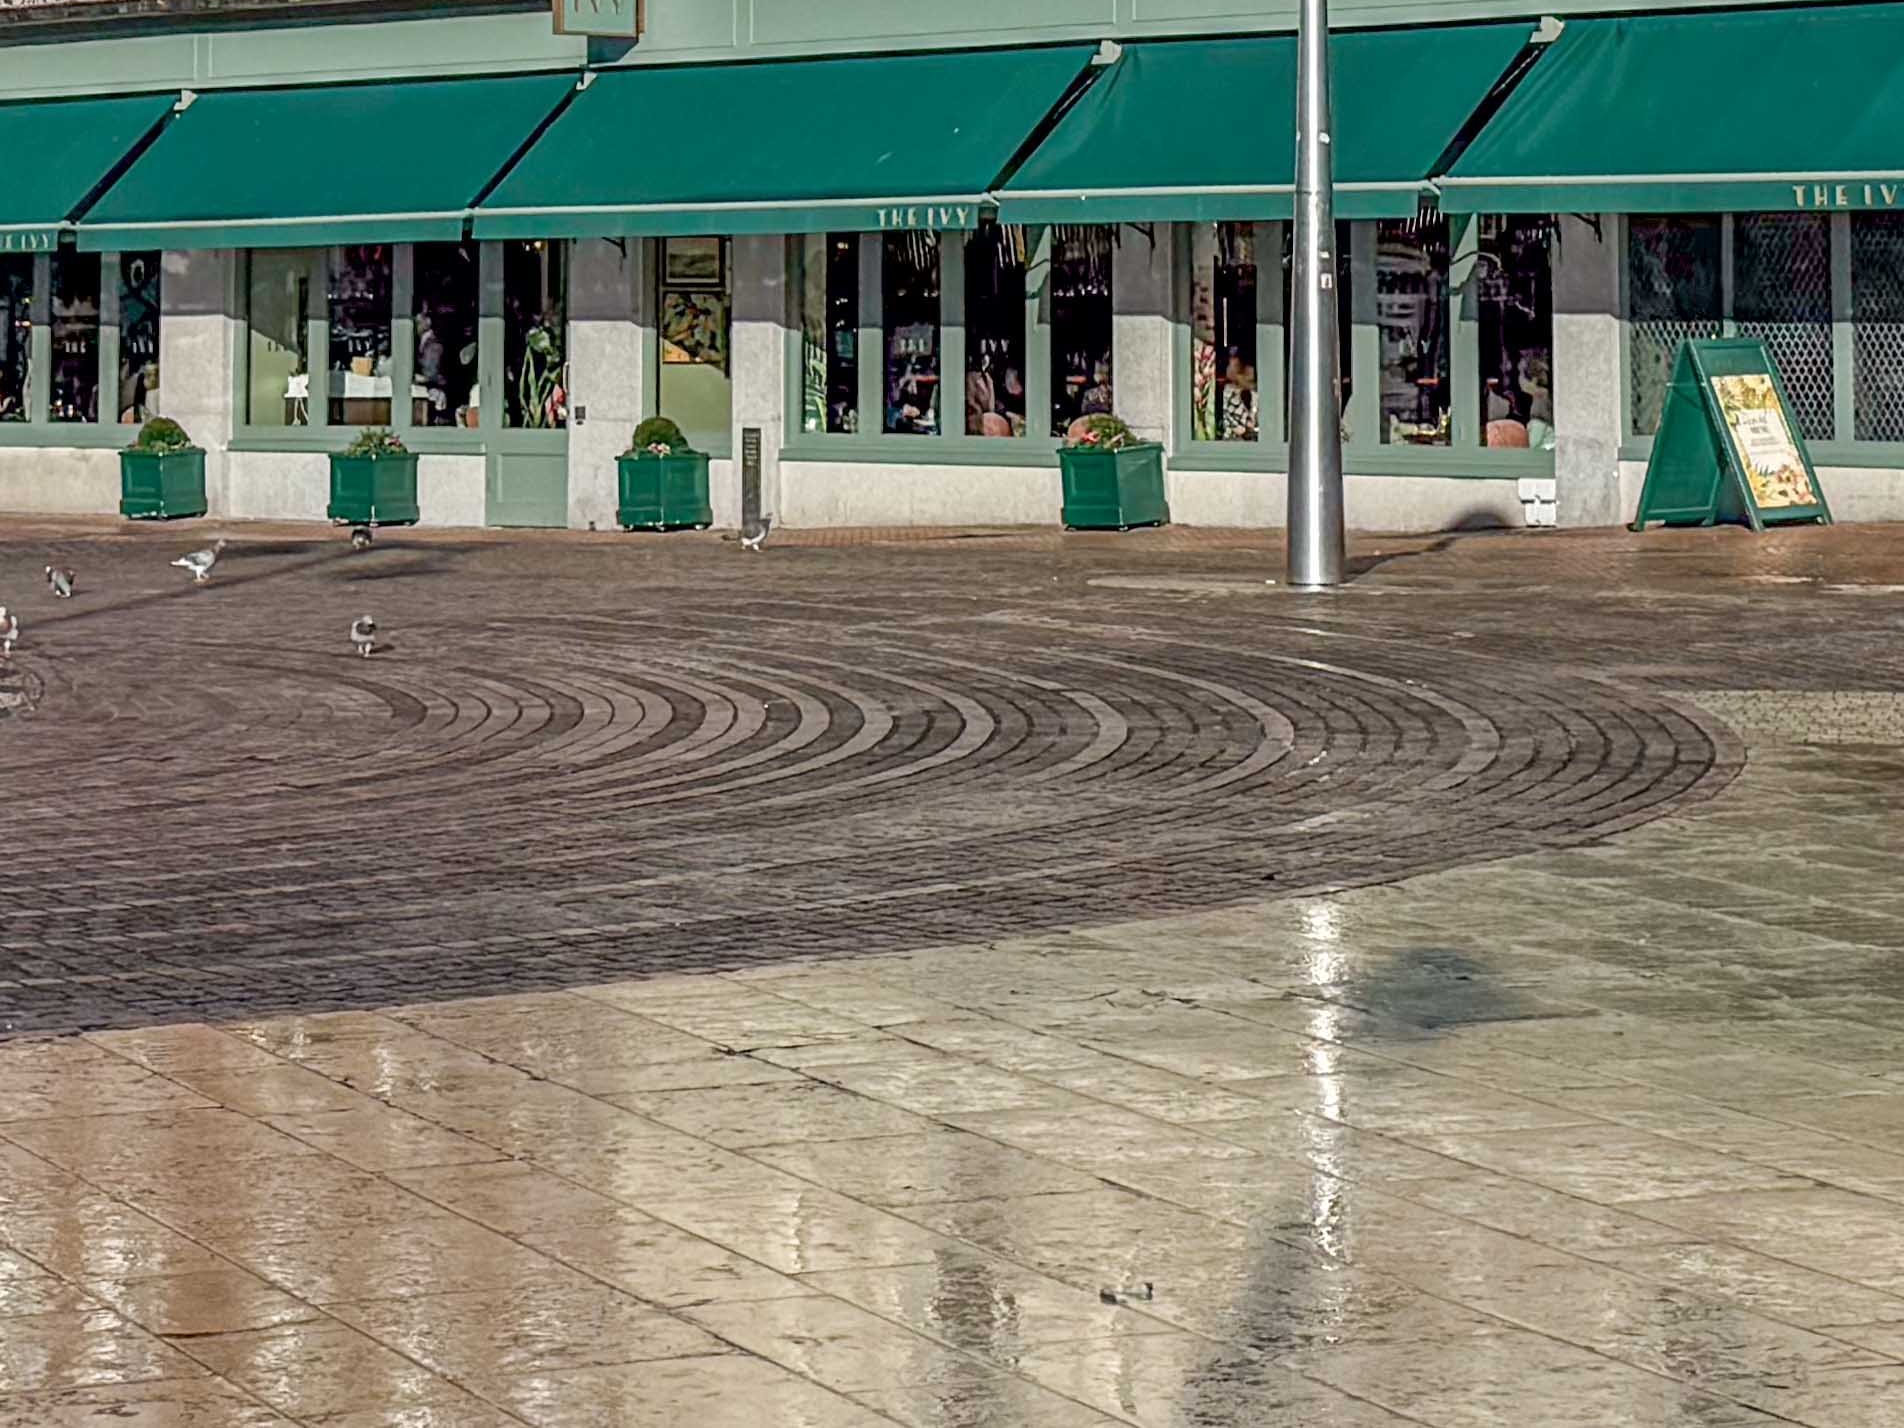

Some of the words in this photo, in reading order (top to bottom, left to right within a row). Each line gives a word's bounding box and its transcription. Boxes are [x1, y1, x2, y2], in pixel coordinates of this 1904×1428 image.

[1792, 184, 1848, 207] THE
[878, 208, 916, 226] THE
[928, 207, 969, 225] IVY
